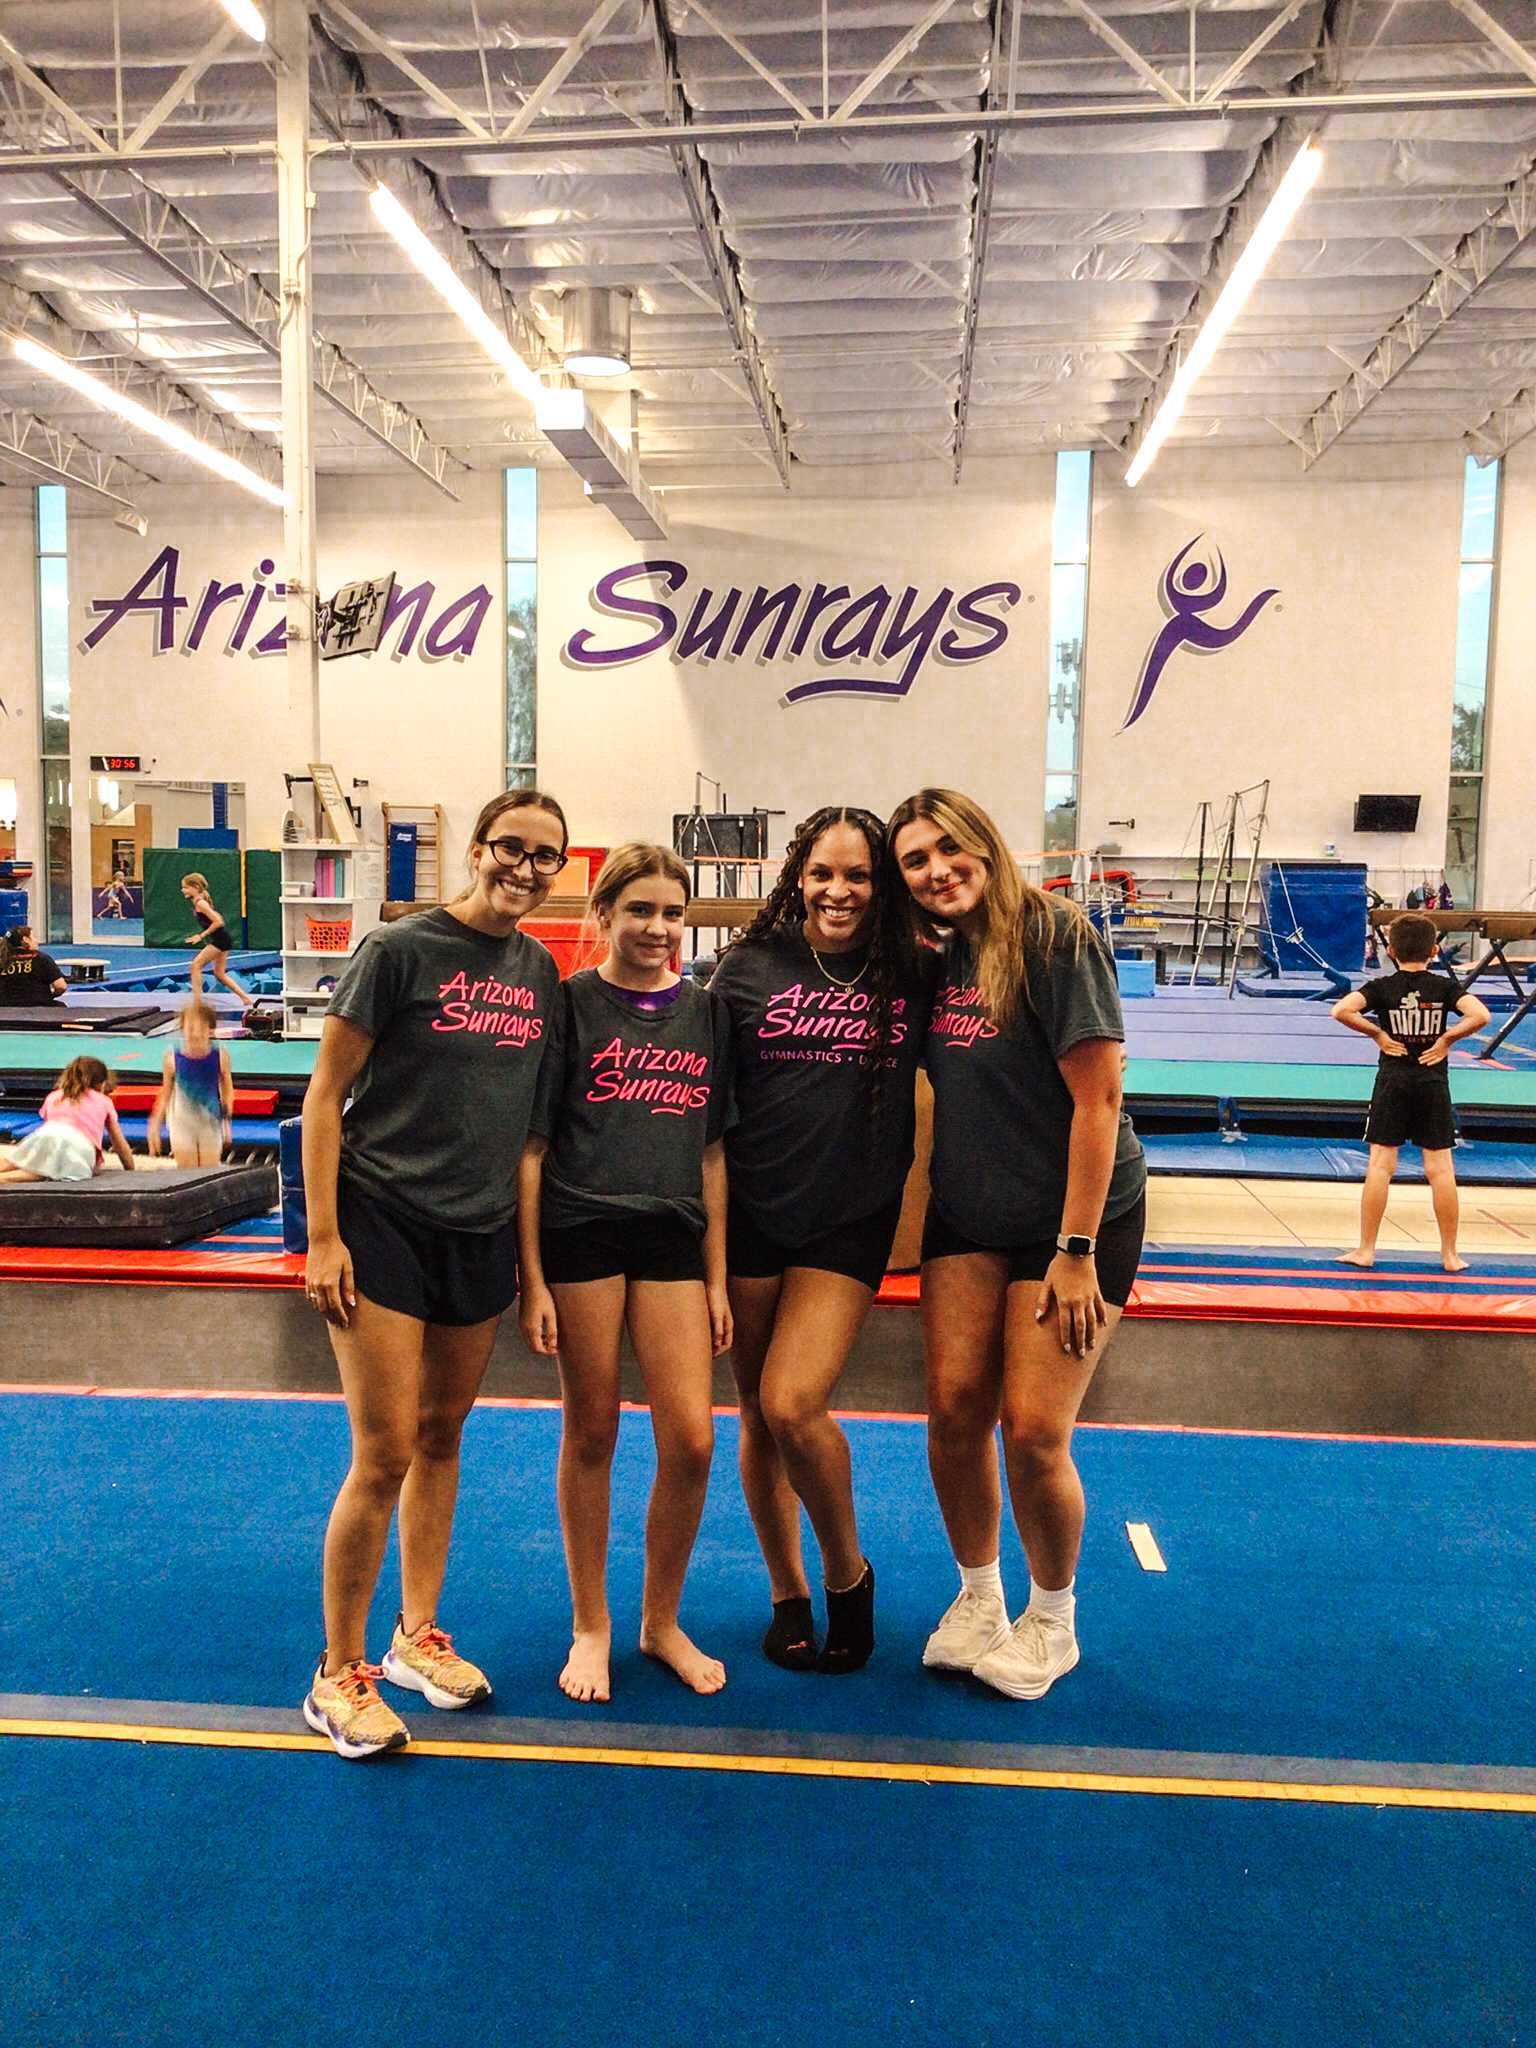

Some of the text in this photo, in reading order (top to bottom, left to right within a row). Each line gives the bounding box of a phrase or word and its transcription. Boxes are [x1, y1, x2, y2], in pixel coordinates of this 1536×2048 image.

[82, 546, 1021, 702] Arizna Sunrays
[438, 970, 535, 1011] Arizona
[432, 1002, 543, 1048] Sunrays
[1388, 1009, 1442, 1036] NINJA
[590, 1036, 709, 1079] Arizona
[760, 1050, 842, 1064] GYMNASTICS
[586, 1070, 710, 1116] Sunrays
